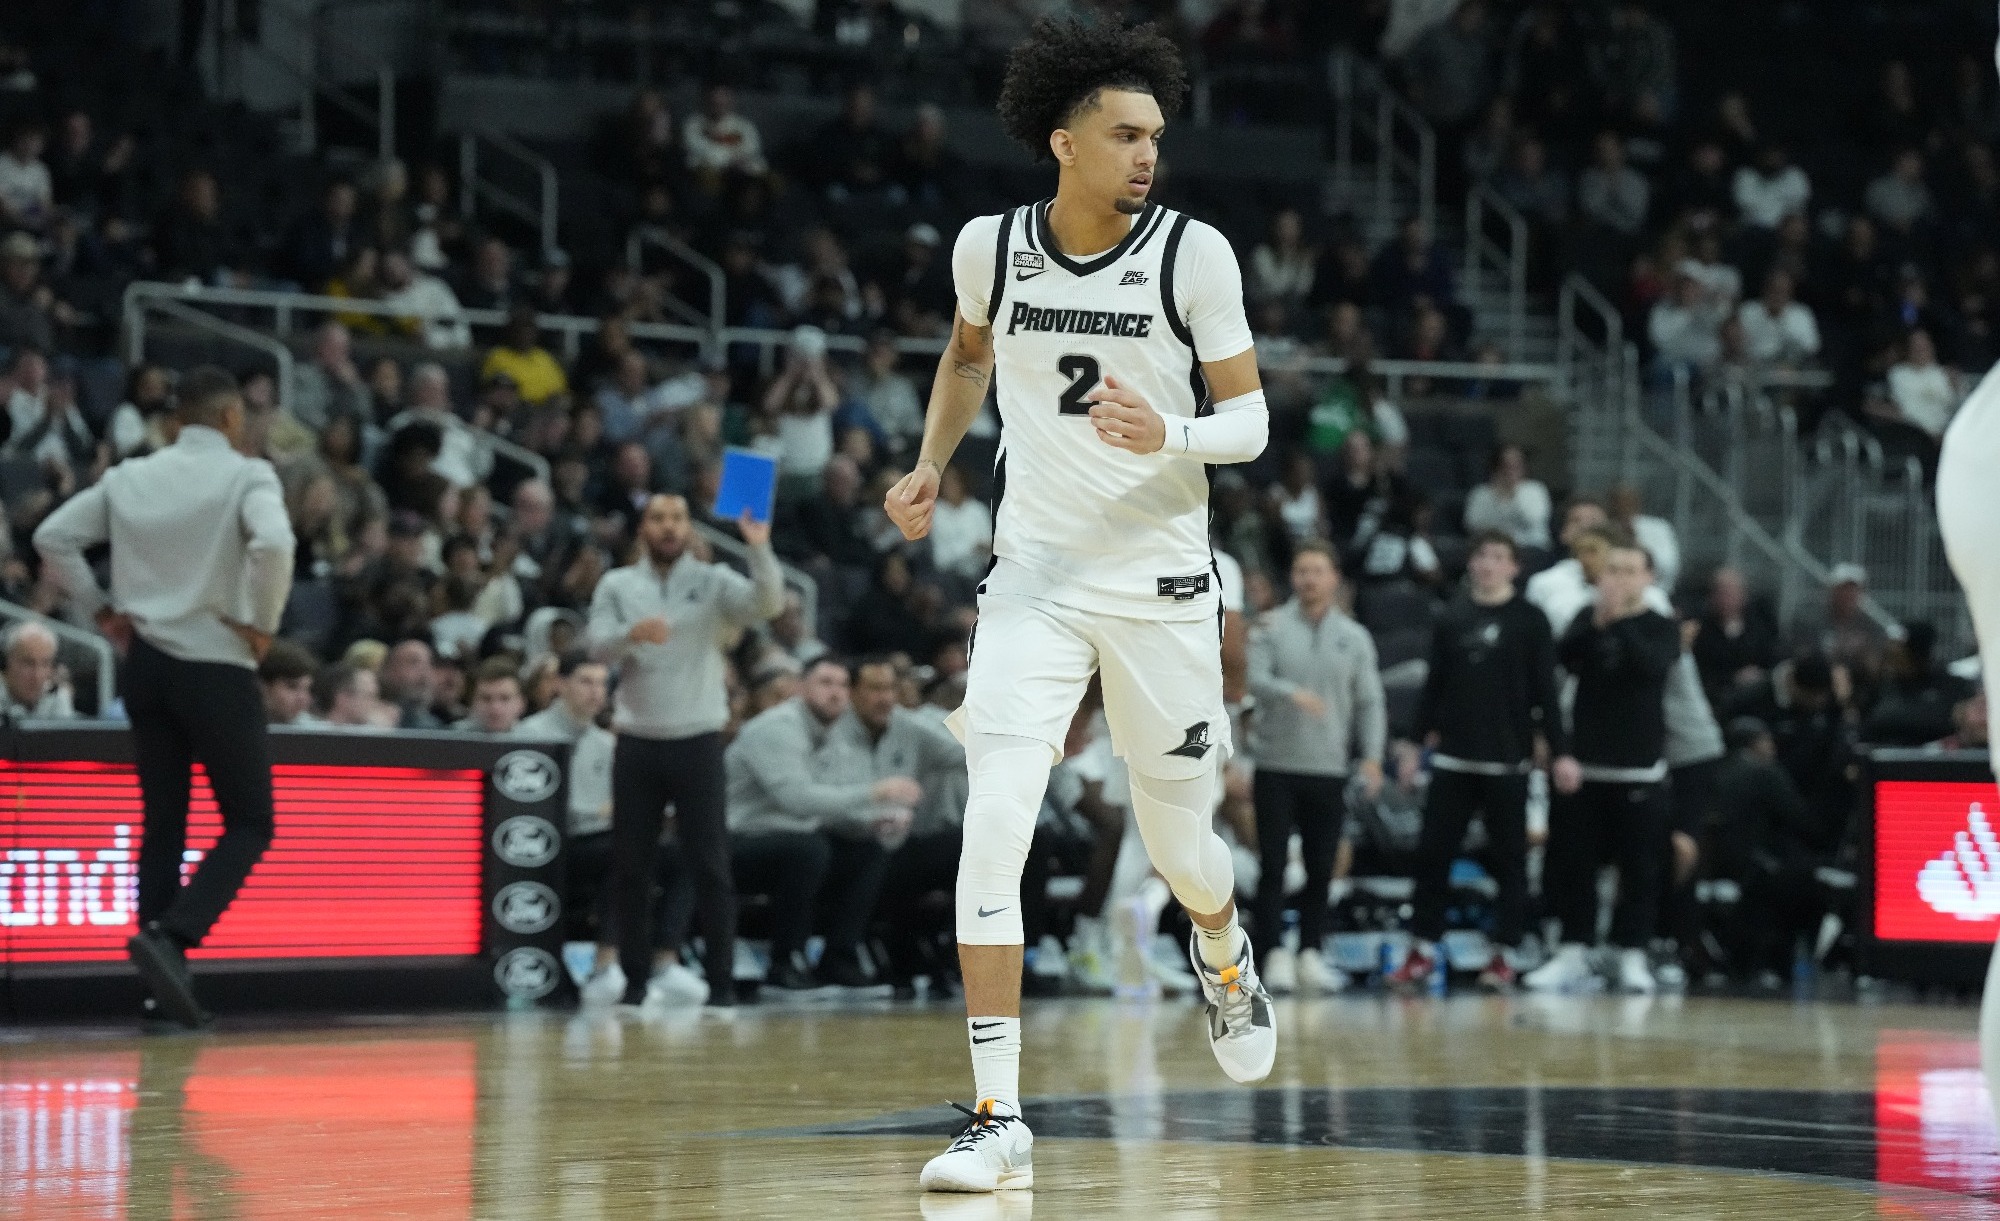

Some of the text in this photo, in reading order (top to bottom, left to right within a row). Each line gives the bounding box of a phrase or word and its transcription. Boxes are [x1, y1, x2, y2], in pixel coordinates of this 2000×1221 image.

[1120, 276, 1149, 284] EAST
[1007, 301, 1154, 338] PROVIDENCE
[1056, 352, 1102, 417] 2
